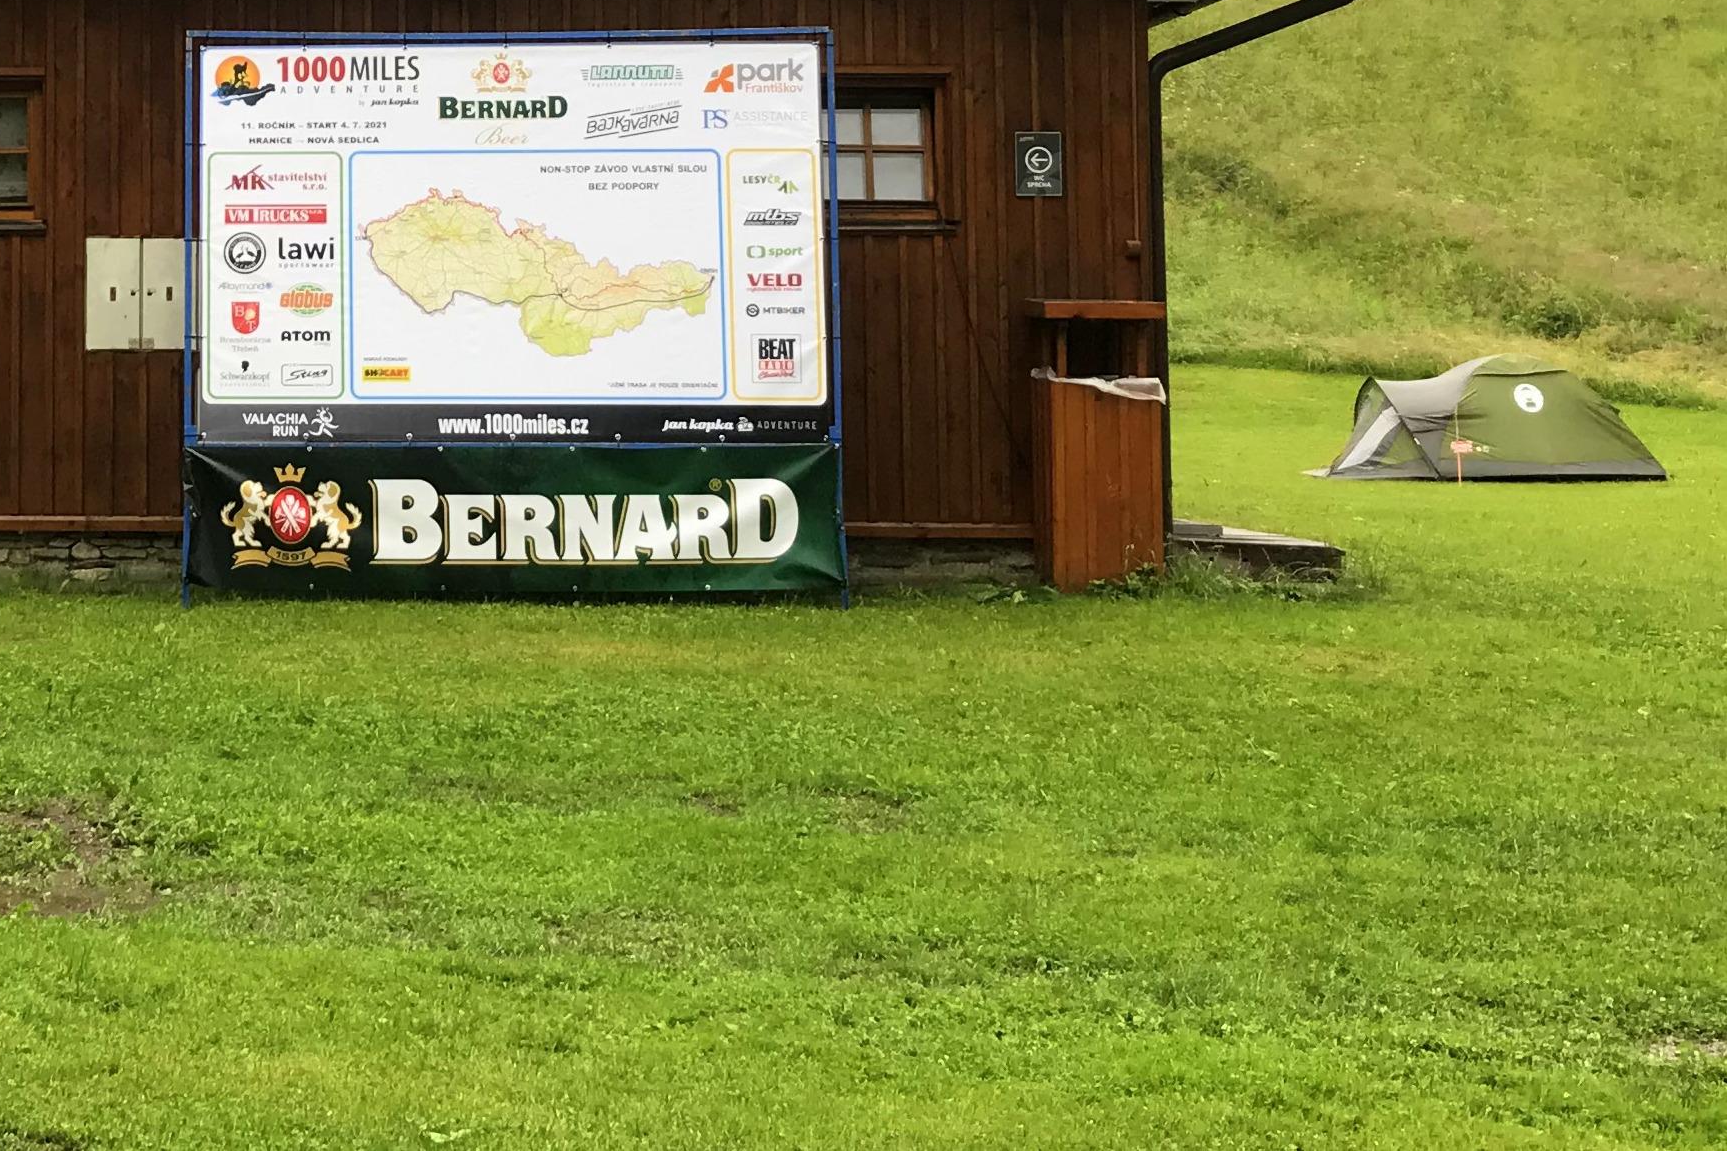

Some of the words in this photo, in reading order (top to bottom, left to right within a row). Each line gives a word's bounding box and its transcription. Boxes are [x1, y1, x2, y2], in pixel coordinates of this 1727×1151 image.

[277, 55, 346, 82] 1000
[350, 55, 421, 81] MILES
[737, 58, 804, 90] park
[280, 84, 419, 94] ADVENTURE
[745, 82, 803, 93] Františkov
[388, 98, 419, 108] kopka
[438, 95, 569, 120] BERNARD
[733, 111, 809, 121] ASSISTANCE
[258, 120, 296, 130] ROČNÍK
[306, 121, 337, 129] START
[364, 121, 387, 129] 2021
[249, 136, 293, 144] HRANICE
[307, 134, 335, 144] NOVÁ
[338, 136, 379, 144] SEDLICA
[475, 122, 530, 145] Beer
[539, 165, 591, 174] NON-STOP
[594, 163, 628, 173] ZÁVOD
[632, 163, 674, 173] VLASTNÍ
[677, 164, 708, 173] SILOU
[267, 172, 327, 182] stavitelství
[588, 182, 608, 191] BEZ
[611, 182, 660, 191] PODPORY
[227, 208, 250, 222] VM
[252, 207, 310, 222] TRUCKS
[278, 237, 334, 260] lawi
[768, 246, 803, 258] sport
[746, 273, 803, 287] VELO
[281, 330, 331, 341] ATOM
[758, 338, 796, 360] BEAT
[242, 413, 308, 425] VALACHIA
[438, 413, 589, 435] www.1000miles.cz
[272, 425, 299, 437] RUN
[661, 419, 687, 432] jan
[688, 418, 735, 433] kopka
[757, 420, 818, 430] ADVENTURE
[368, 478, 799, 566] BERNARD
[275, 550, 307, 560] 1597
